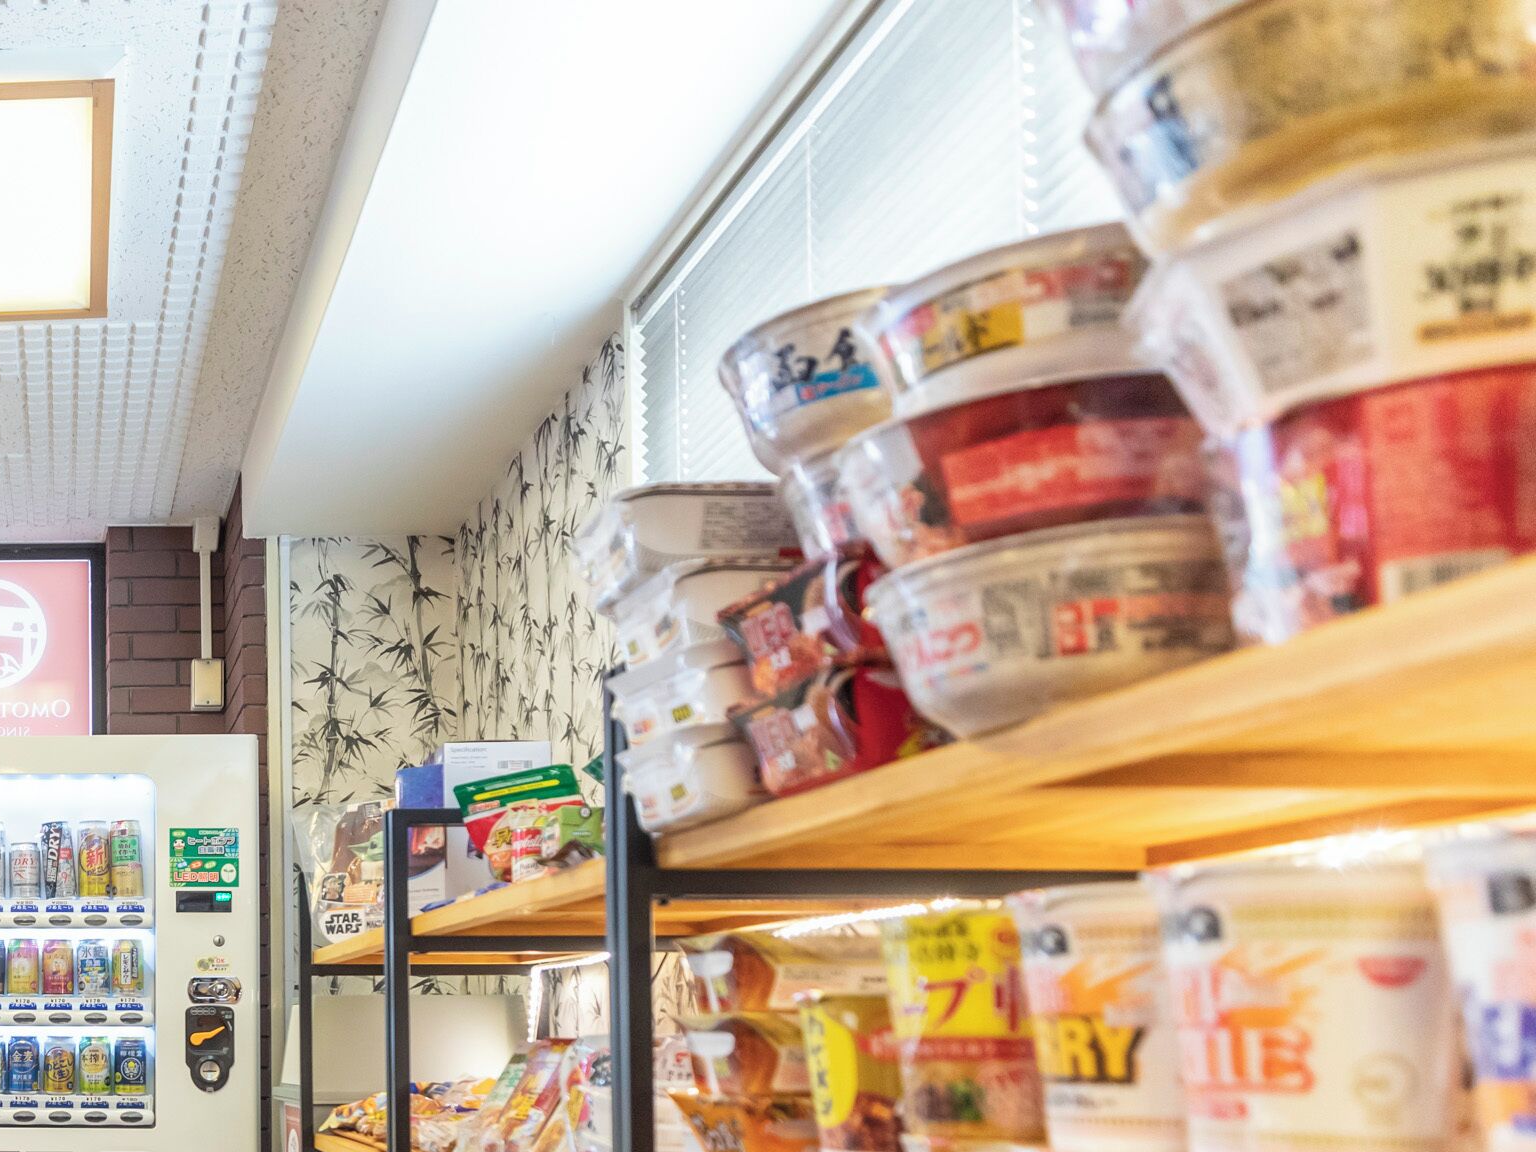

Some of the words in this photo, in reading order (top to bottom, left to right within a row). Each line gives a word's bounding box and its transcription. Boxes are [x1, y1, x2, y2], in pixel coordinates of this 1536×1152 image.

[85, 846, 104, 870] 新
[173, 871, 220, 883] LED照明
[325, 912, 362, 924] STAR
[325, 922, 363, 935] WARS
[12, 1050, 33, 1062] 金麦
